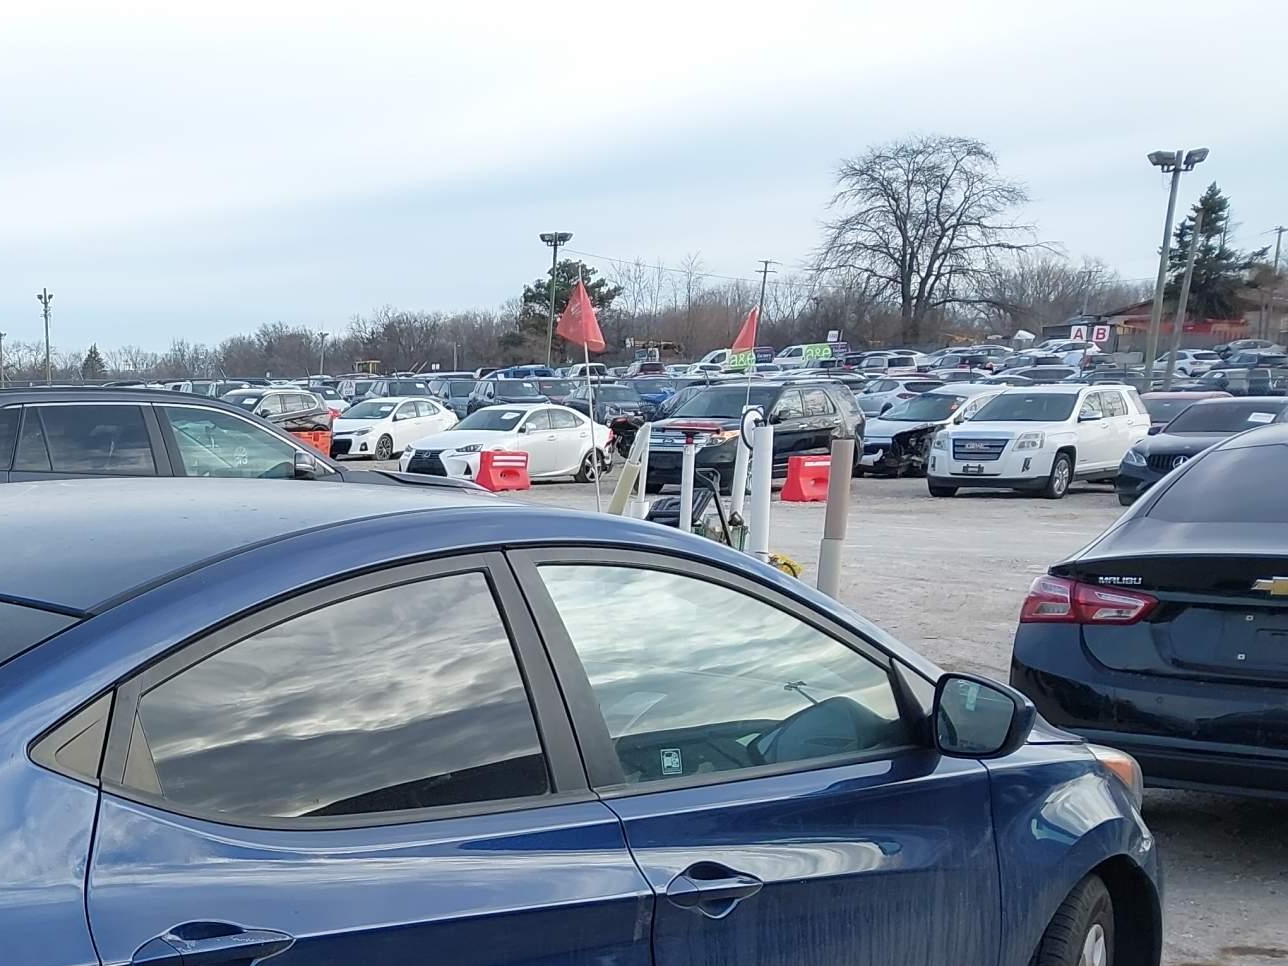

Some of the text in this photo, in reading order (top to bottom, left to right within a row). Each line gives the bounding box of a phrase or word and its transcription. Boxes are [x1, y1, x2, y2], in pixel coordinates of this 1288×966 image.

[1073, 327, 1107, 340] A B
[1098, 576, 1142, 585] MALIBU
